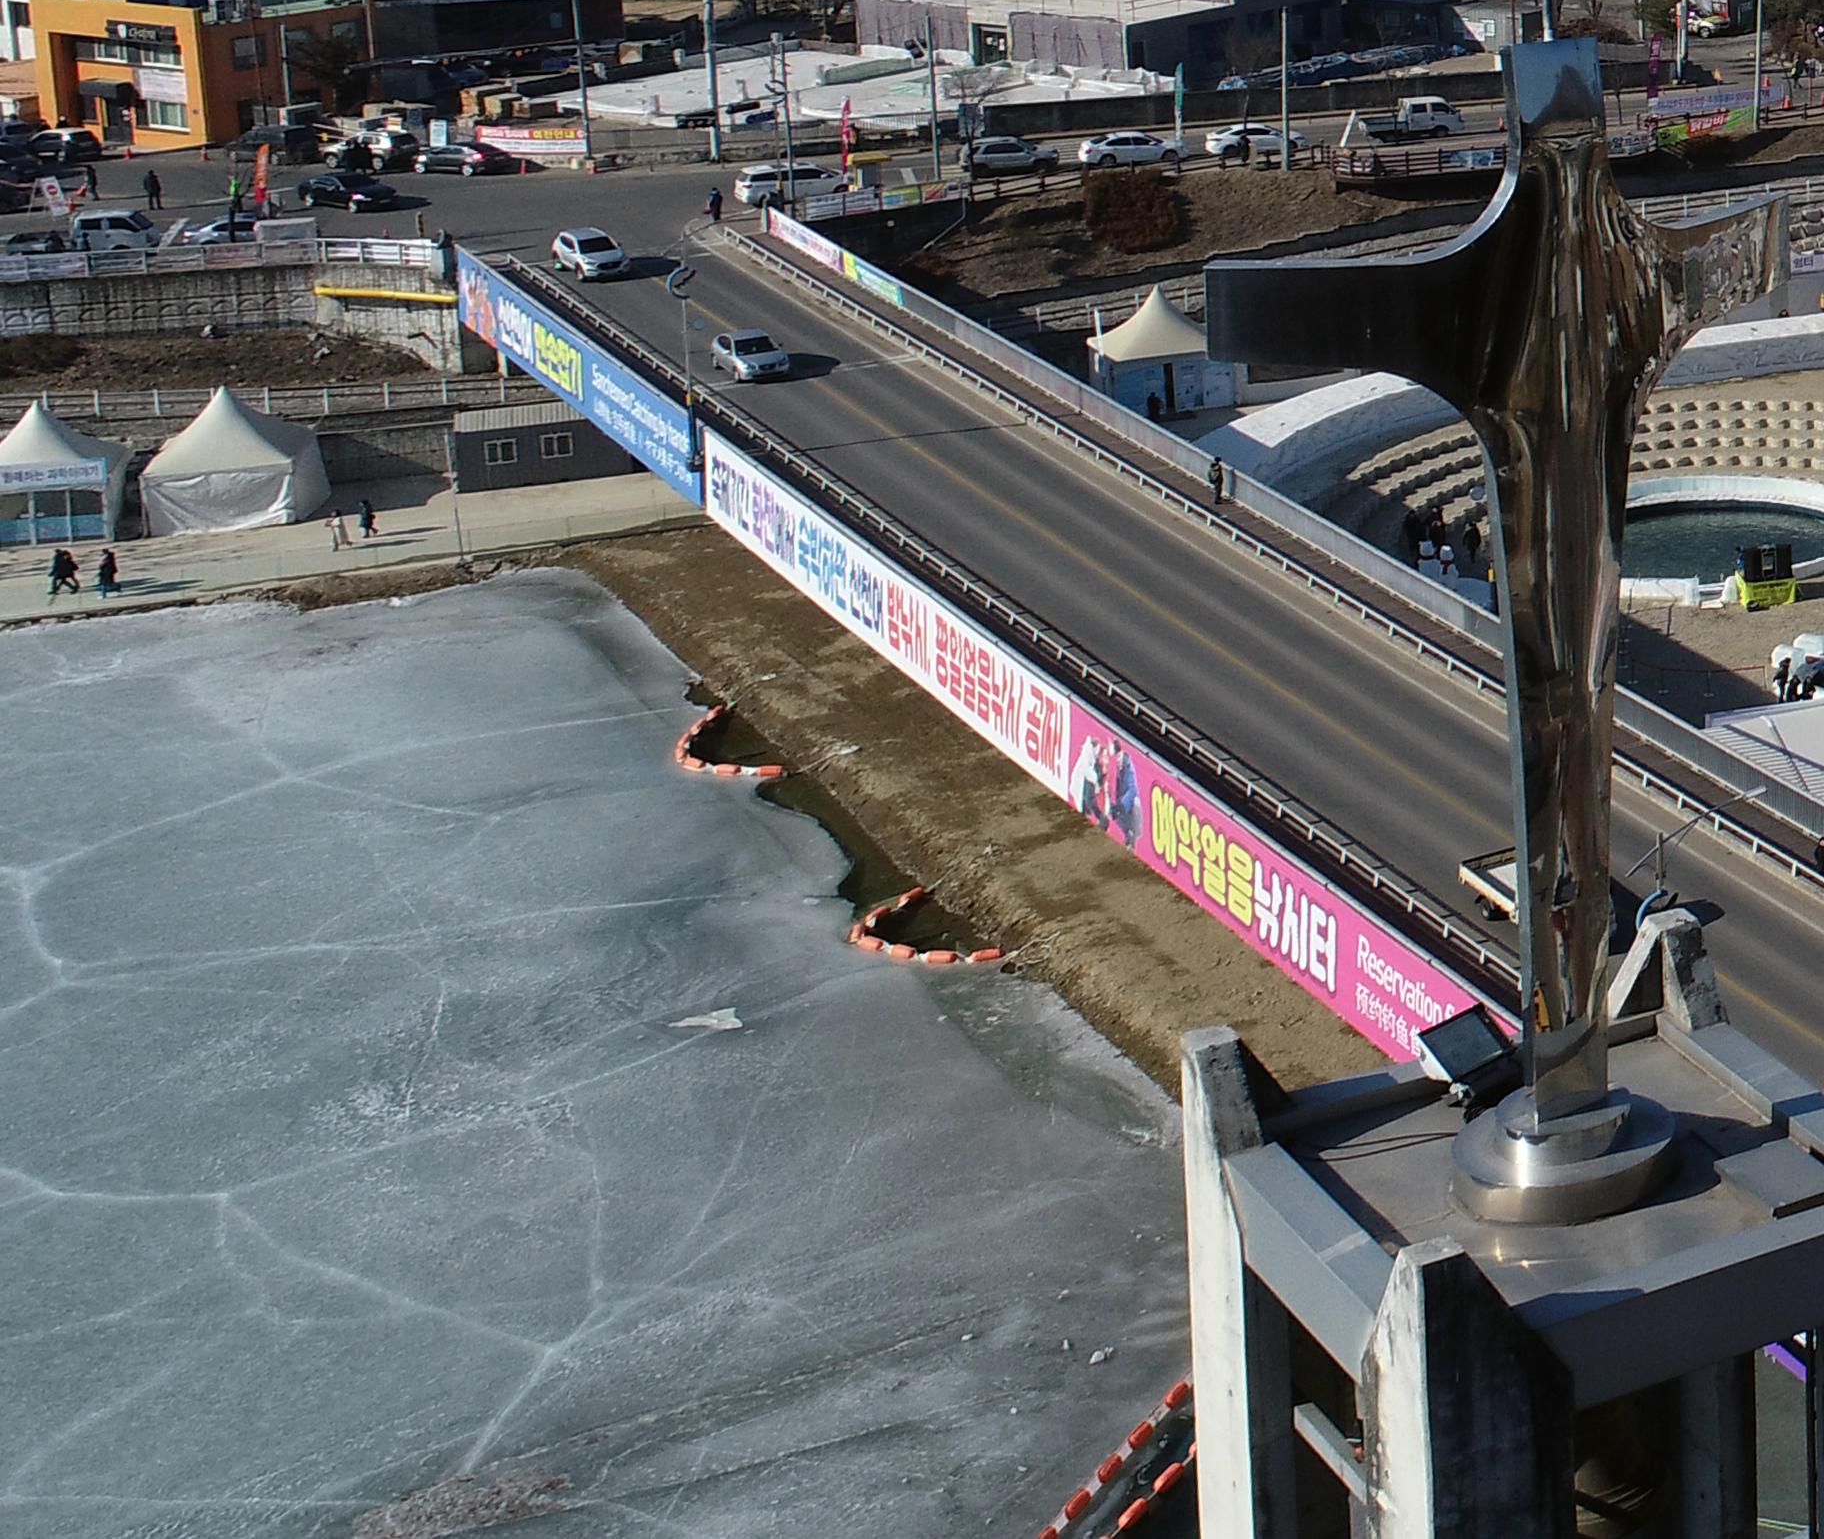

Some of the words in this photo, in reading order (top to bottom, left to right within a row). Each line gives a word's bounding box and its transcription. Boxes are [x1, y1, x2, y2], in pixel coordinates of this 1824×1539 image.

[1793, 255, 1814, 269] 쉼터
[499, 297, 533, 364] 산천어
[534, 322, 584, 402] 맨손잡기
[711, 455, 750, 532] 축제기간
[751, 477, 796, 569] 화천에서
[797, 514, 847, 611] 숙박하면
[849, 558, 884, 639] 산천어
[1025, 682, 1064, 779] 공짜!
[1151, 785, 1337, 993] 예약얼음낚시터
[1357, 934, 1443, 1024] Reservation
